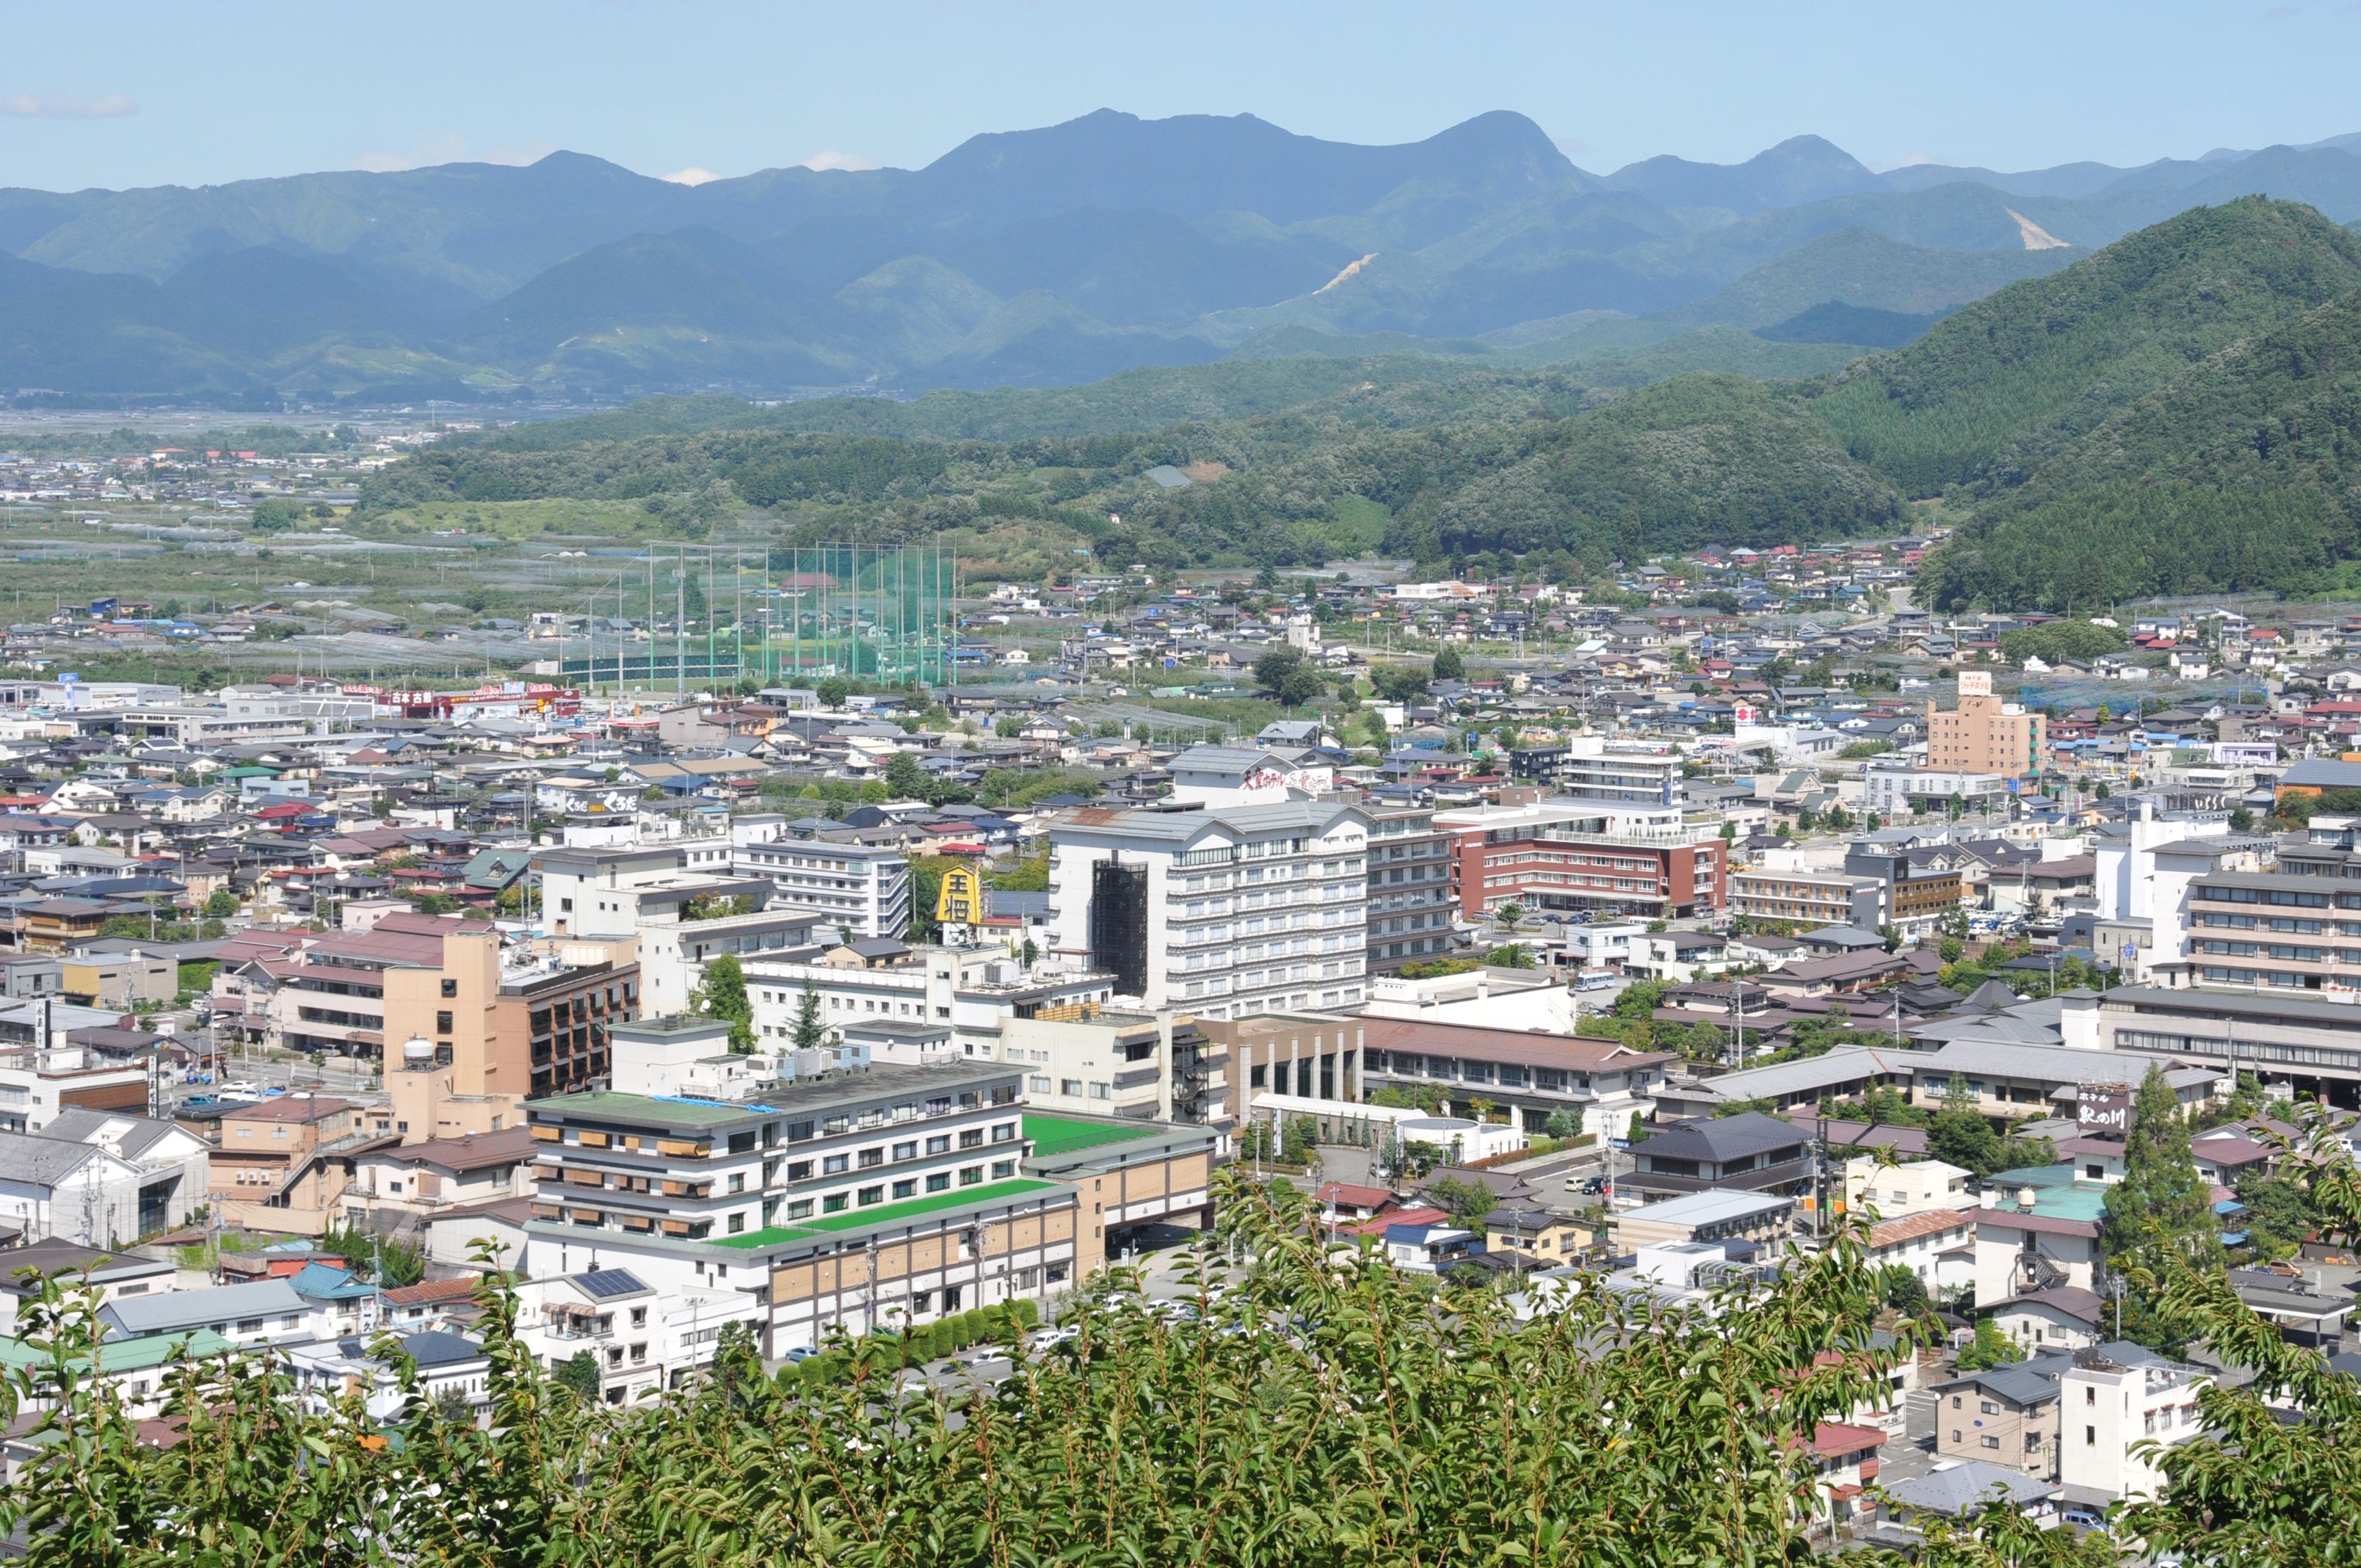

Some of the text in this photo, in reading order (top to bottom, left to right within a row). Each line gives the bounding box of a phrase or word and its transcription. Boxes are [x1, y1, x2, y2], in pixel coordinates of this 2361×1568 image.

[566, 797, 588, 812] くろだ
[603, 791, 638, 813] くろだ
[943, 874, 970, 922] 王将
[2078, 1092, 2109, 1103] ホテル
[2078, 1104, 2126, 1129] 紀の川
[363, 1313, 372, 1332] 一久
